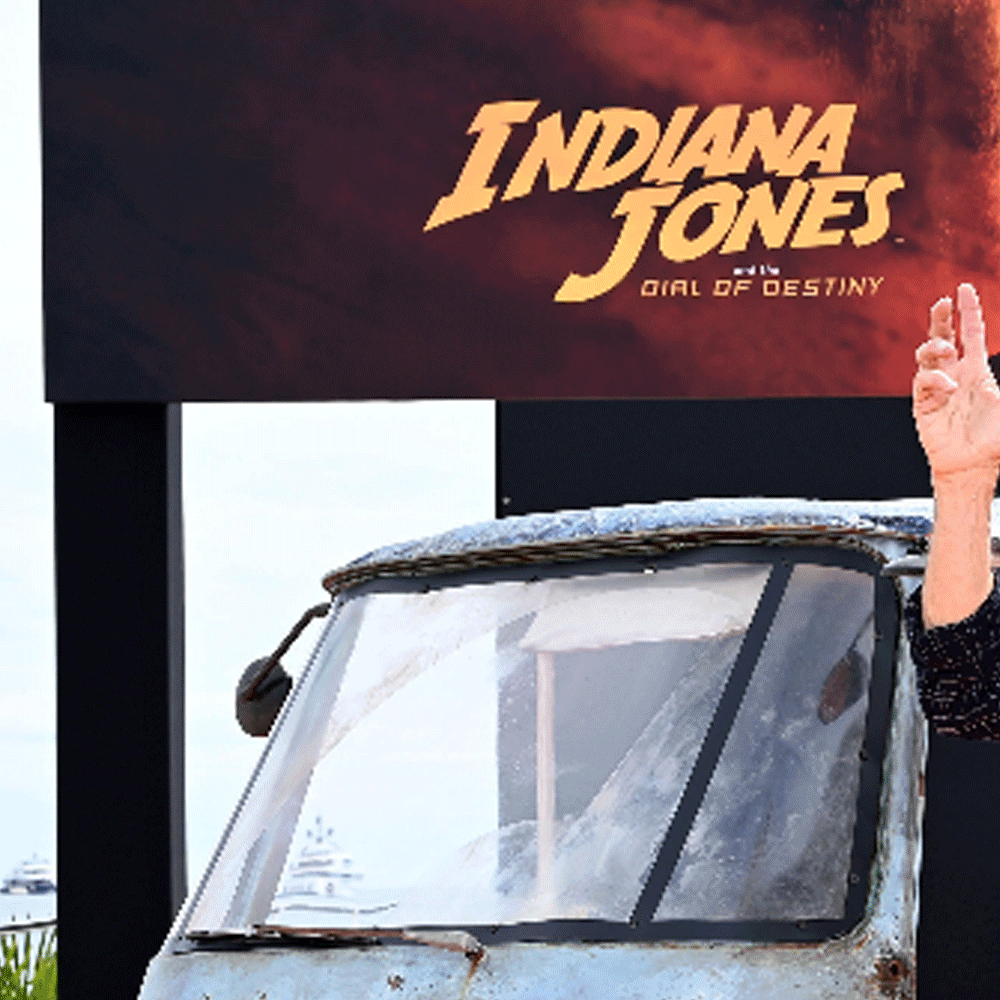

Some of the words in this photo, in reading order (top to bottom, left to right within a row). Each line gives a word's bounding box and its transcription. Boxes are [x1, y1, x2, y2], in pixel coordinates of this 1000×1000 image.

[423, 99, 858, 233] INDIANA
[553, 172, 905, 303] JONES
[640, 278, 702, 297] DIAL
[712, 278, 753, 297] OF
[762, 276, 885, 297] DESTINY
